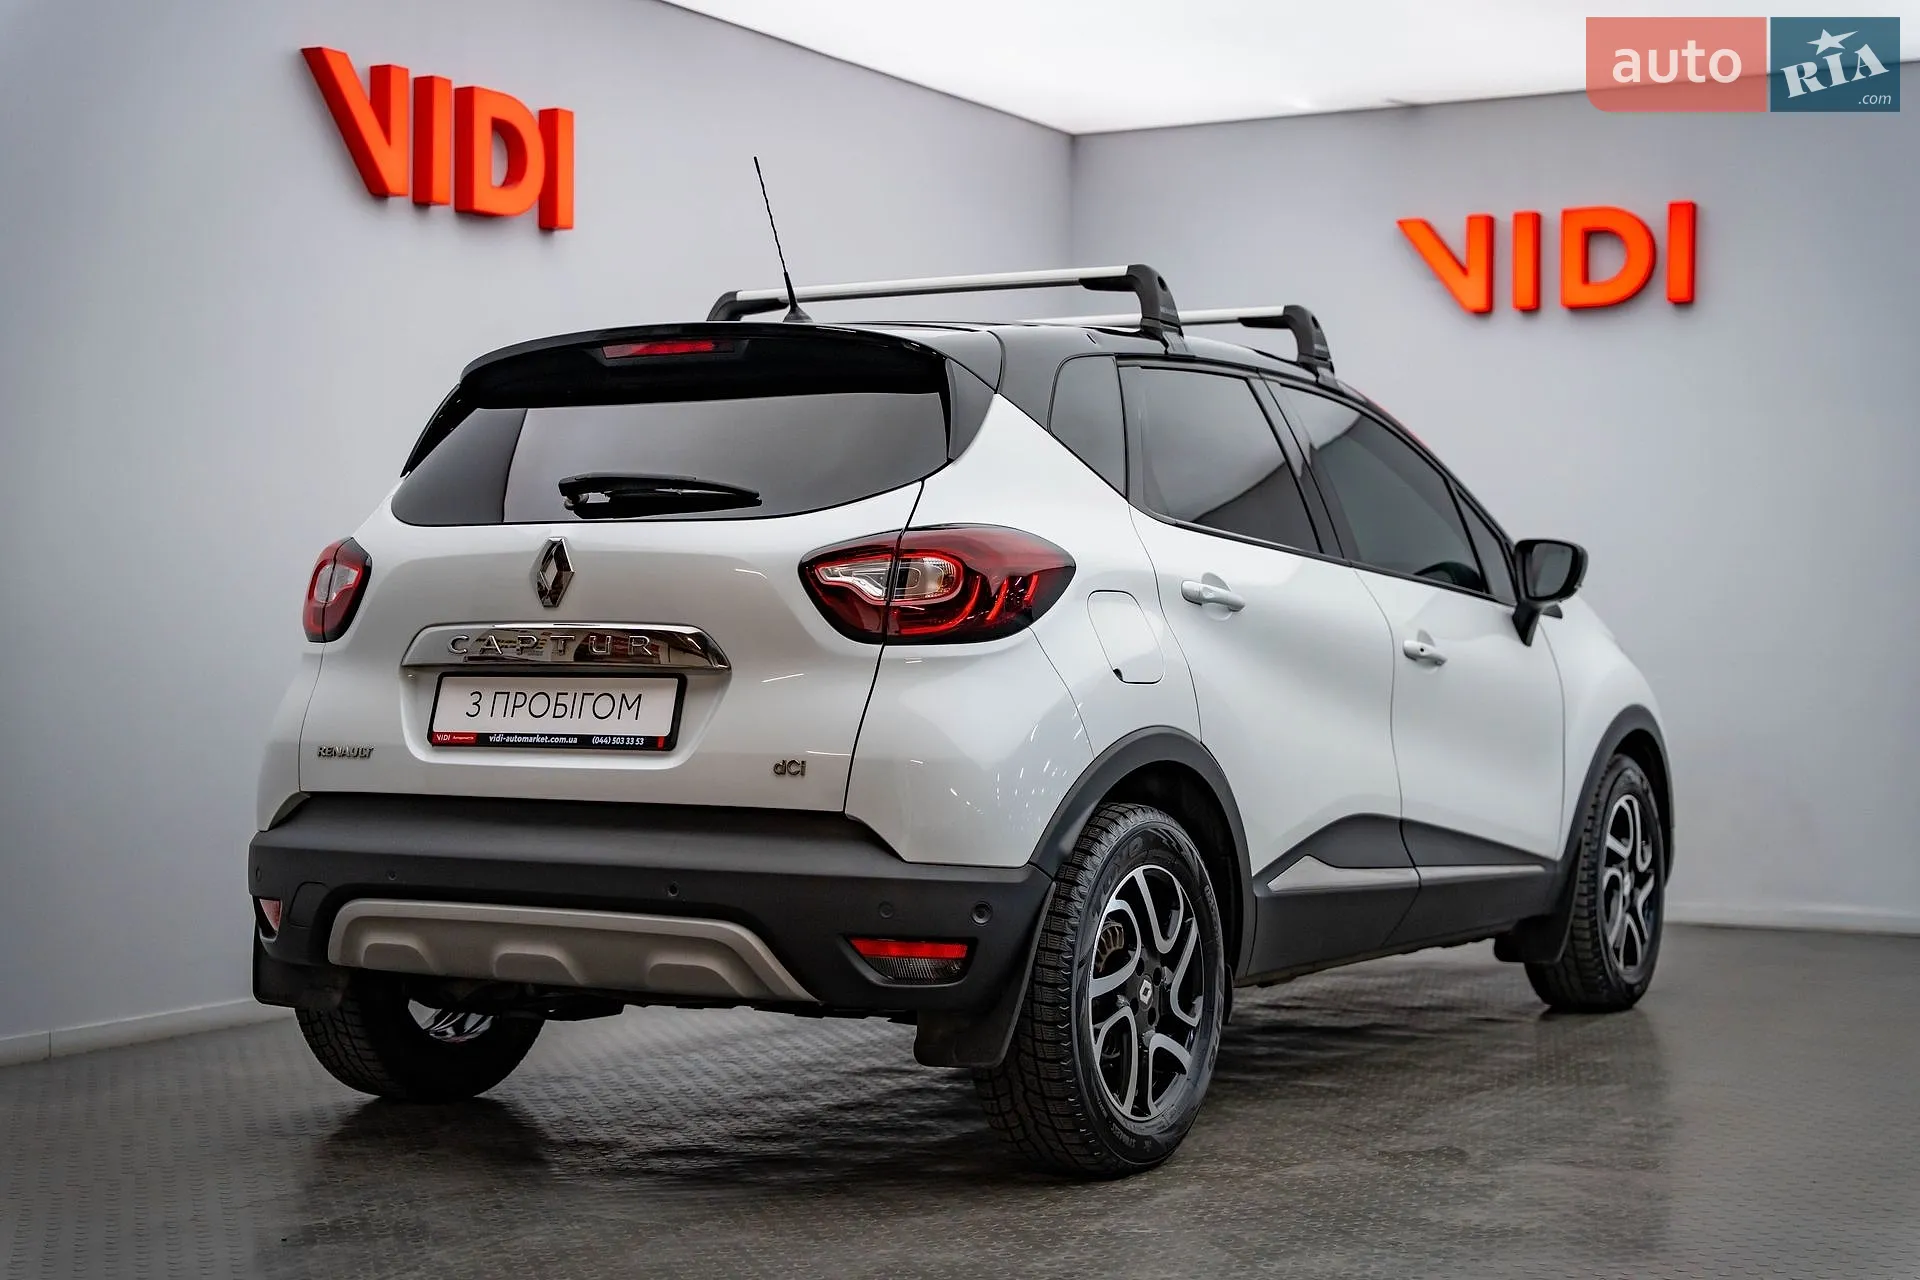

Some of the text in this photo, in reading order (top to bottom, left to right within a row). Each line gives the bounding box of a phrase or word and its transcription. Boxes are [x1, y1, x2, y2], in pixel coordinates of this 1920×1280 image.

[301, 46, 574, 230] VIDI
[1396, 200, 1696, 314] VIDI
[449, 635, 652, 655] CAPTUR
[489, 691, 643, 720] ПРОБІГОМ
[489, 734, 644, 745] vidi-automarket.com.ua (044) 503 33 53
[318, 746, 374, 758] RENAULT
[773, 760, 806, 776] dCi
